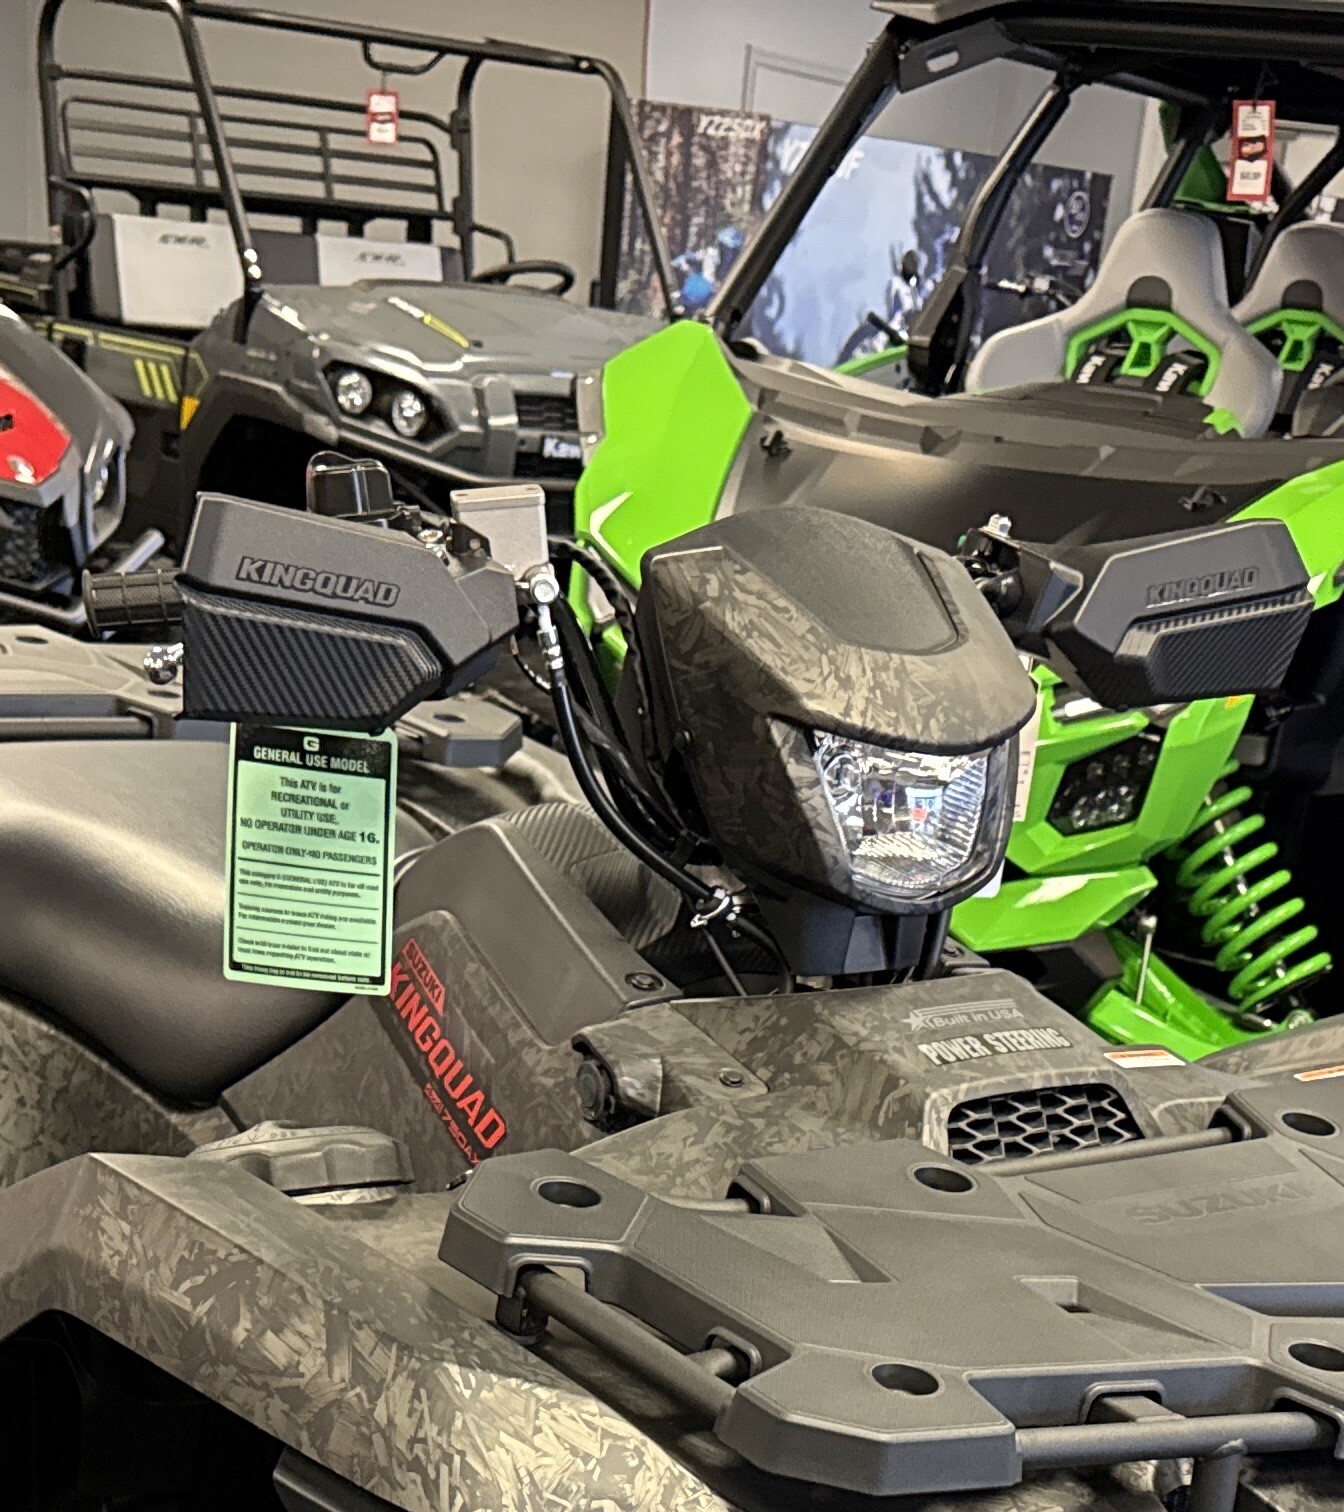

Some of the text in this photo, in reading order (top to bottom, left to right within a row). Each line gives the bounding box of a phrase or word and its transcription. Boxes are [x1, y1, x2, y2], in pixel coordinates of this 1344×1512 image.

[236, 556, 400, 607] KINGQUAD
[1146, 567, 1259, 608] KINGQUAD
[253, 746, 370, 773] GENERAL USE MODEL
[280, 777, 298, 788] This
[300, 780, 316, 791] ATV
[271, 791, 338, 810] RECREATIONAL
[280, 808, 314, 821] UTILITY
[240, 817, 253, 829] NO
[255, 819, 302, 835] OPERATOR
[304, 826, 336, 839] UNDER
[338, 830, 357, 842] AGE
[242, 840, 284, 855] OPERATOR
[323, 851, 377, 865] PASSENGERS
[406, 941, 444, 1004] SUZUKI
[933, 1008, 1025, 1028] Built in USA
[390, 961, 506, 1149] KINGQUAD
[917, 1028, 1071, 1066] POWER STEERING
[1126, 1183, 1312, 1226] SUZUKI
